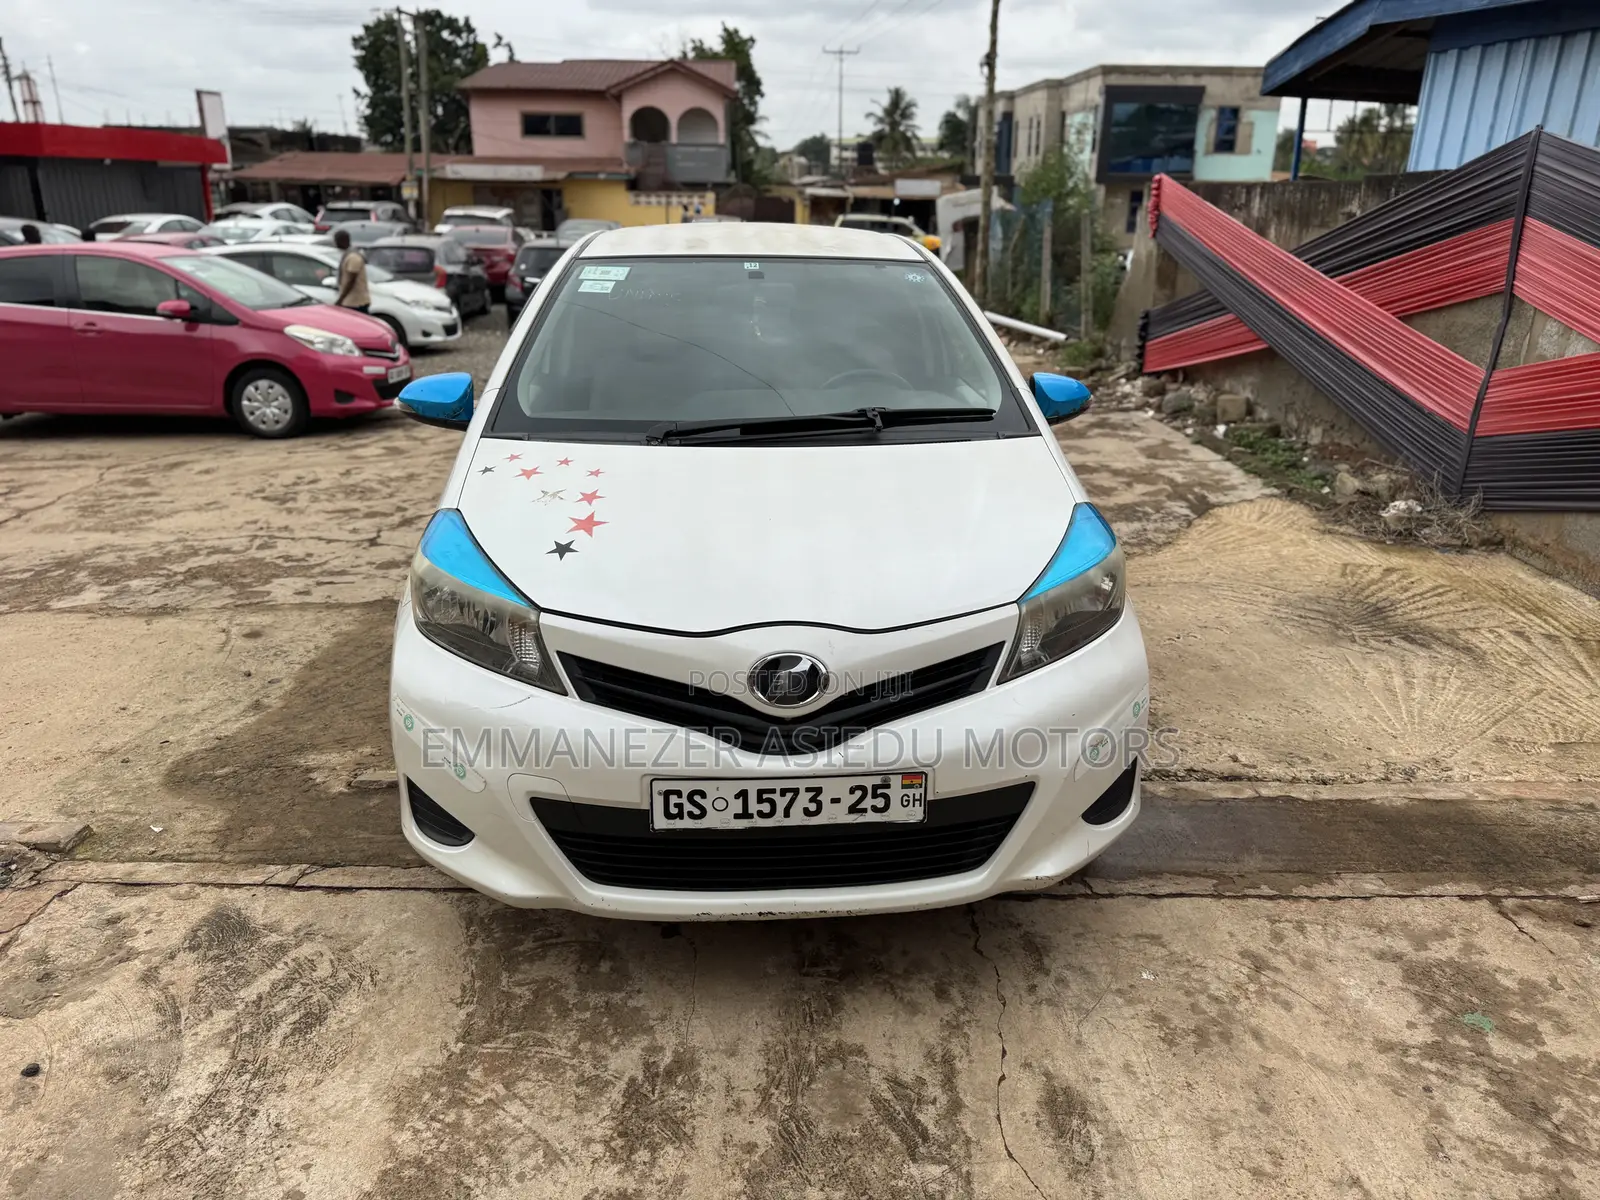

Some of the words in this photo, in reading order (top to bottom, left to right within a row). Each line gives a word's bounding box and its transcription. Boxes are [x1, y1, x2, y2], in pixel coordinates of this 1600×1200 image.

[662, 788, 708, 821] GS
[732, 783, 892, 820] 1573-25
[900, 792, 923, 809] GH
